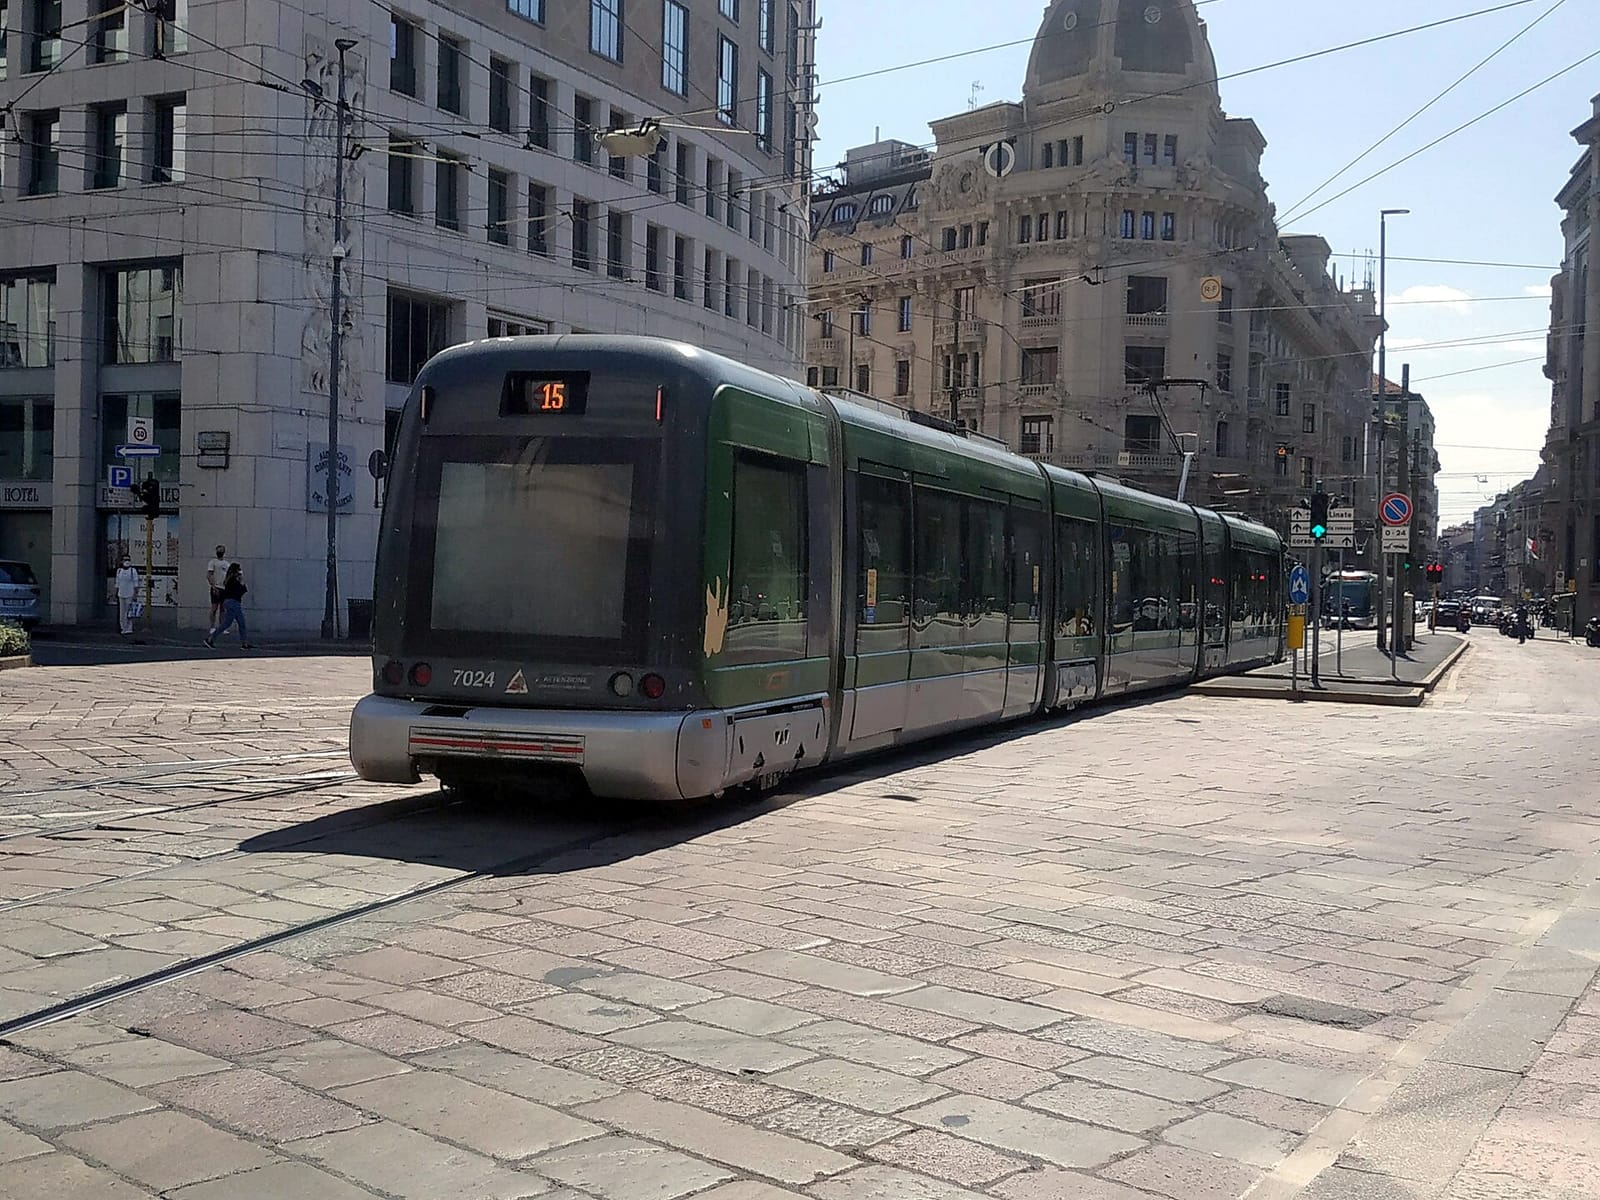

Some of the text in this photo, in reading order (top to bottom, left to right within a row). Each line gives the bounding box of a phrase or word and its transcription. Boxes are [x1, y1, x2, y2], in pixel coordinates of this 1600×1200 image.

[542, 383, 565, 409] 15
[115, 469, 128, 486] P
[4, 487, 39, 502] HOTEL
[1292, 537, 1312, 545] corso
[453, 669, 495, 688] 7024
